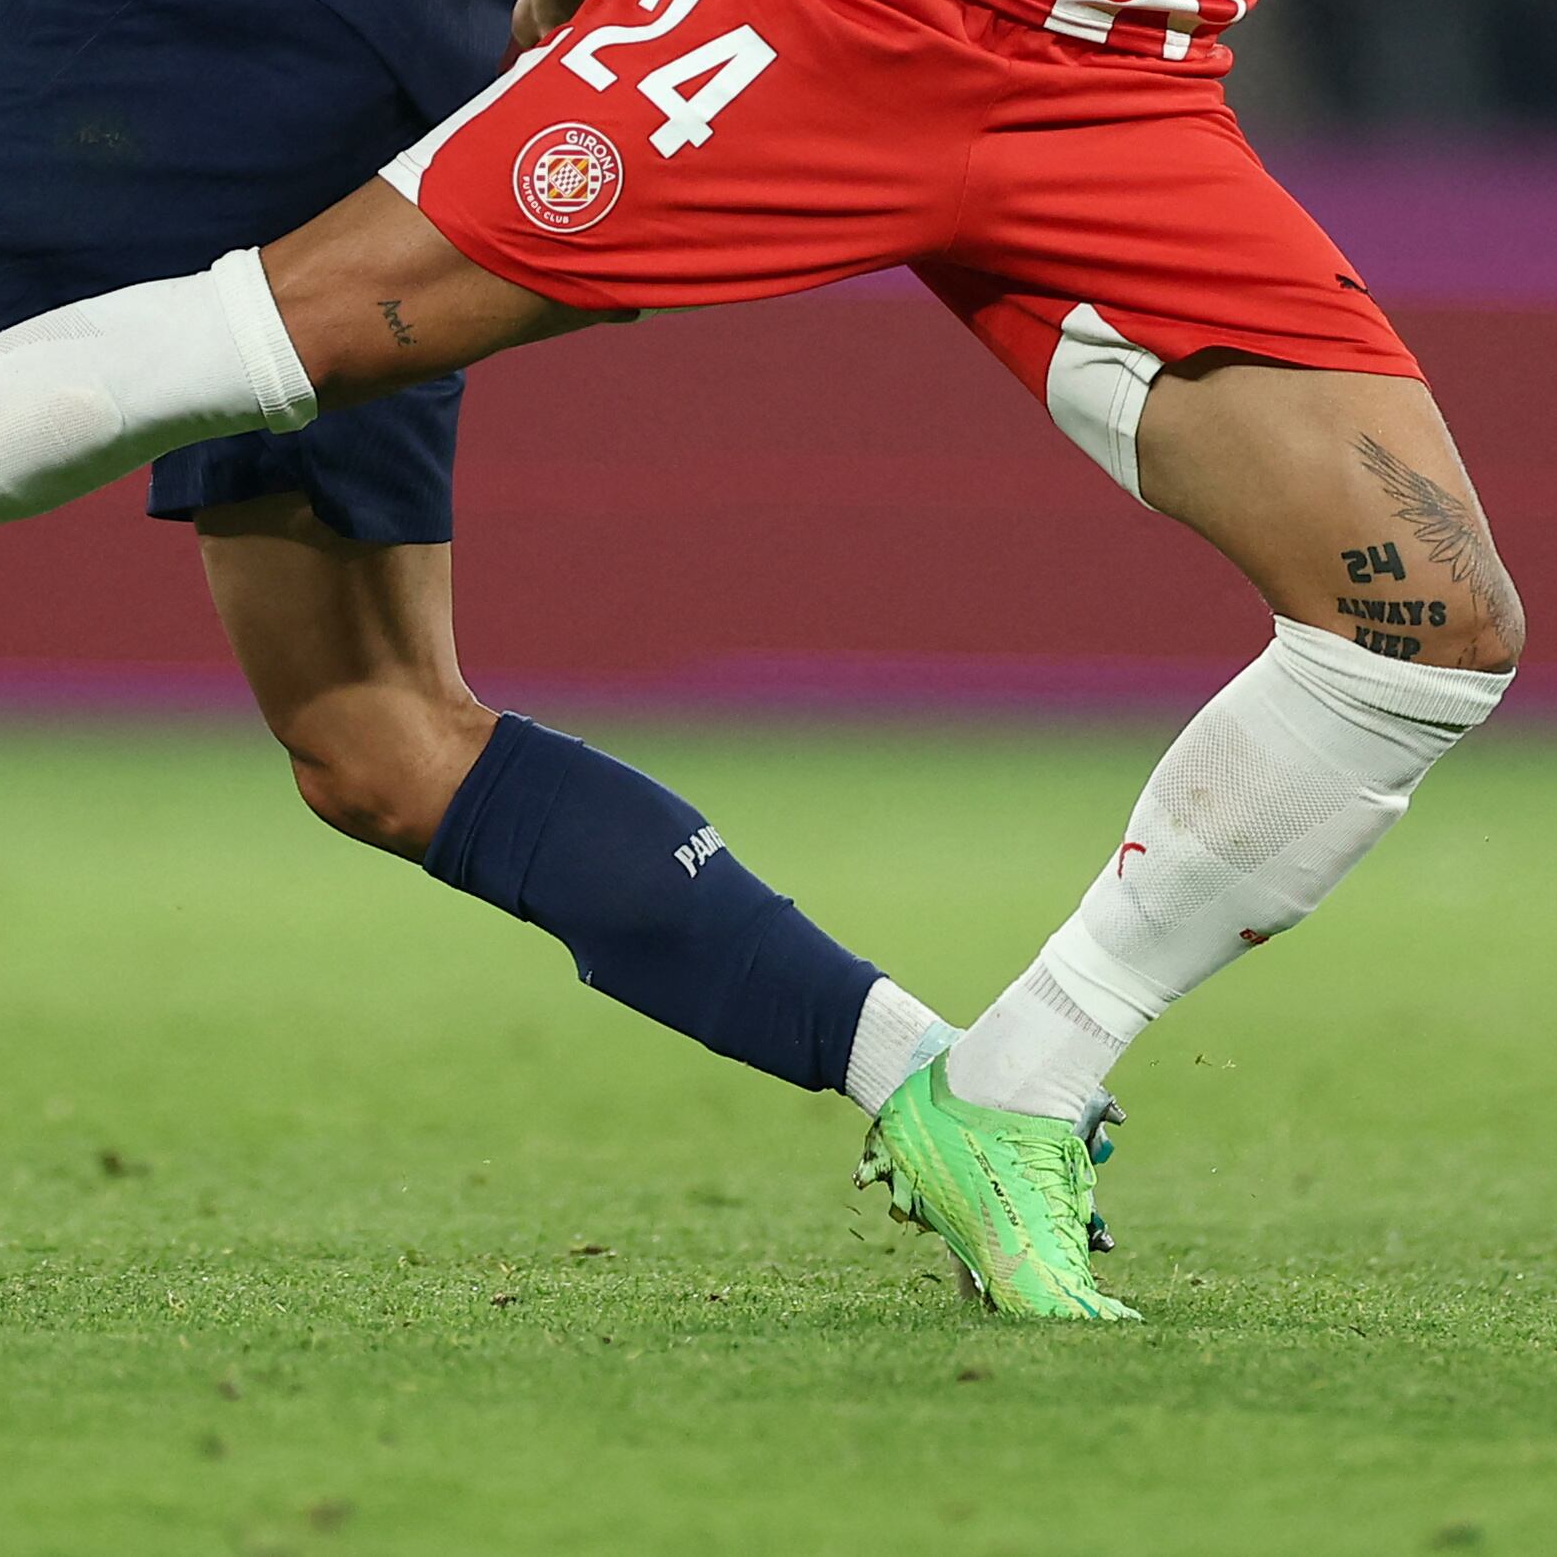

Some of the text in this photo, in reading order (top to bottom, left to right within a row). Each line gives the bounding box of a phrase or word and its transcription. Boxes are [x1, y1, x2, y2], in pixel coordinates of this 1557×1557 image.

[565, 130, 616, 184] GIRONA
[522, 176, 570, 224] FUTBOL CLUB
[1341, 542, 1406, 584] 24
[1337, 597, 1447, 627] ALWAYS
[673, 825, 726, 878] PARI
